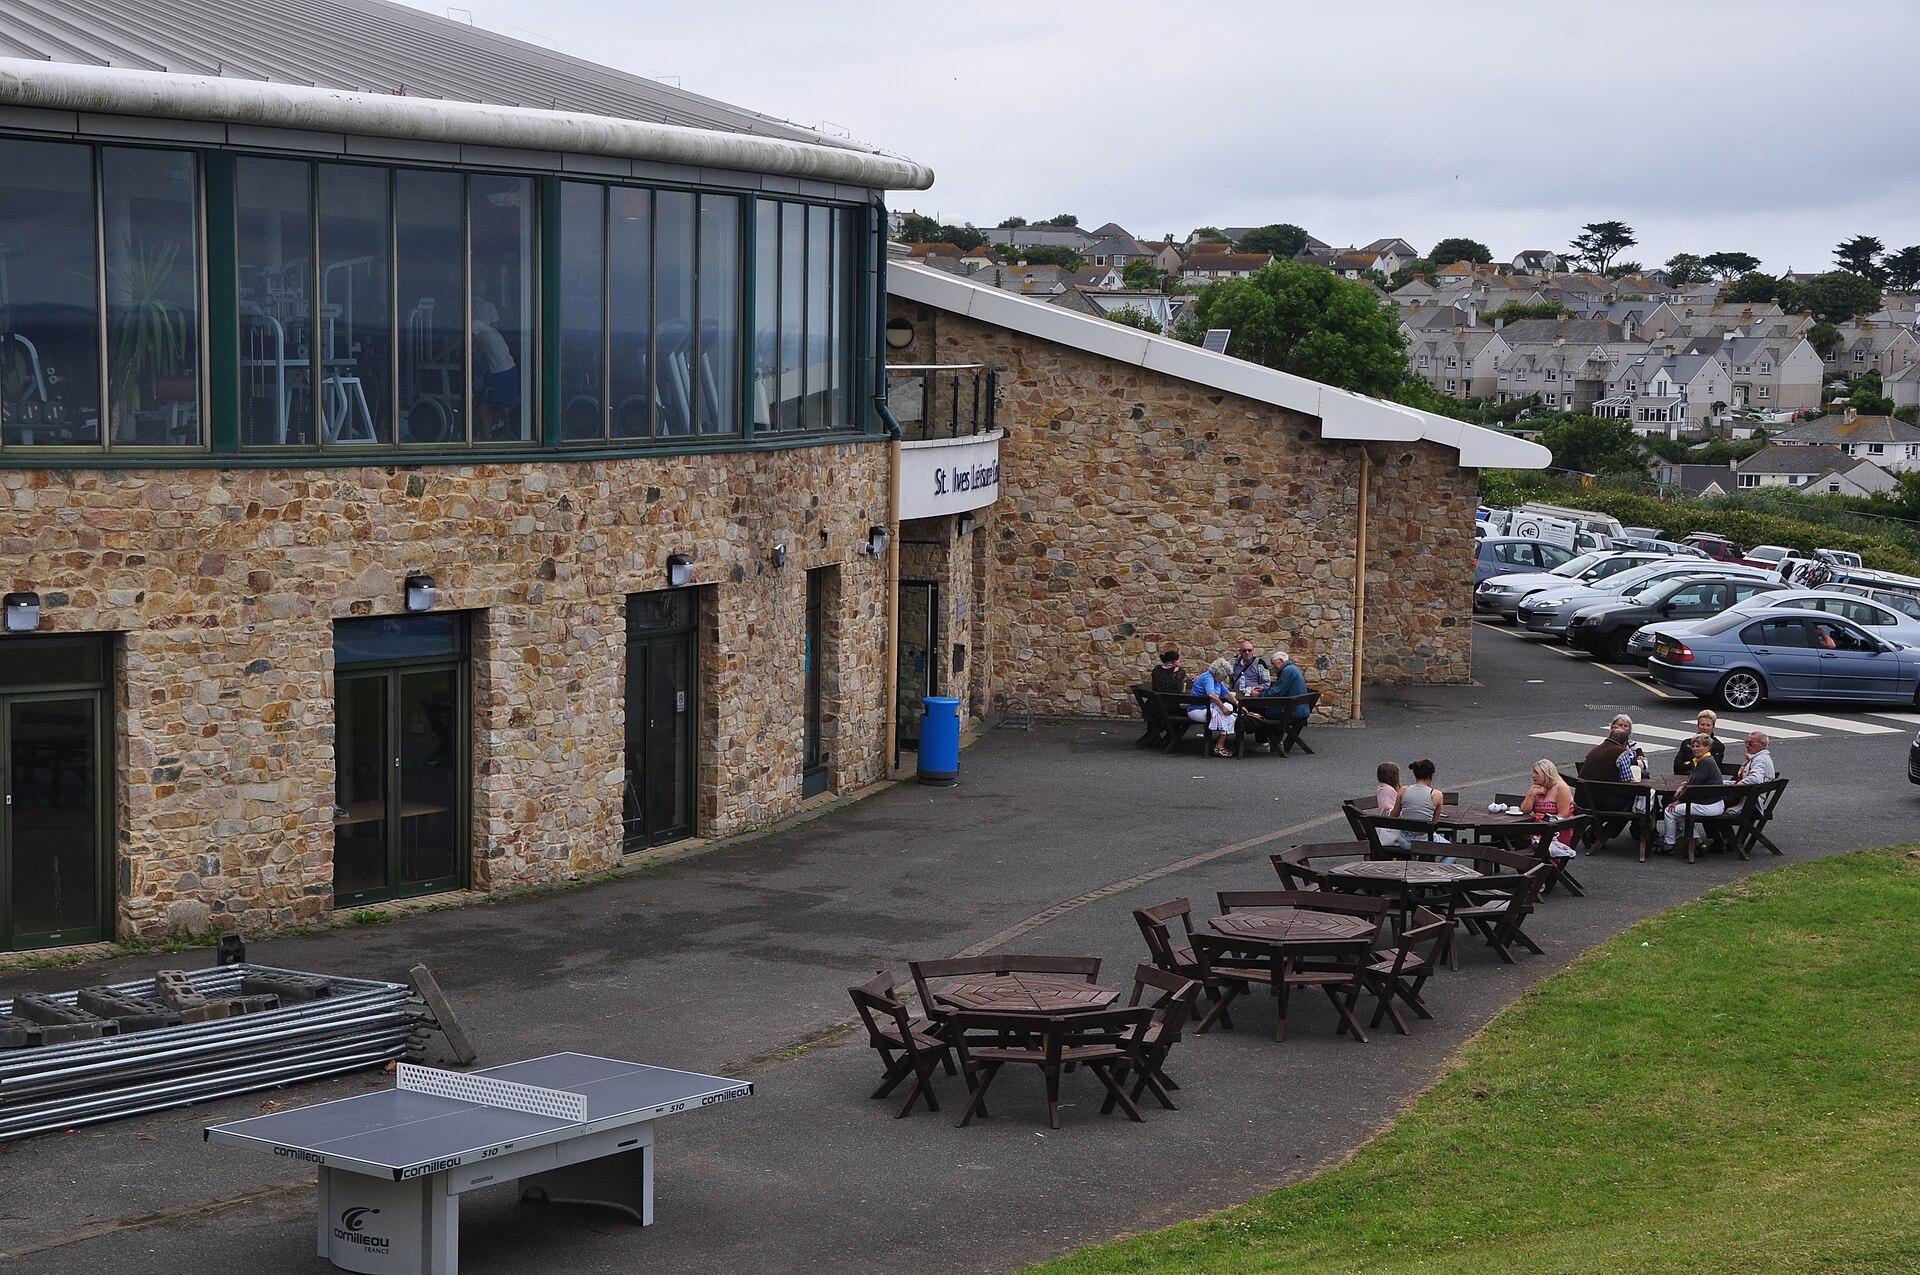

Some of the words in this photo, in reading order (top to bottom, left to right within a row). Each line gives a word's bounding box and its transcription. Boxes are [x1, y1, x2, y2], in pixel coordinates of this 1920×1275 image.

[934, 468, 949, 495] St.
[952, 467, 970, 492] Ives
[971, 463, 992, 490] Leisure
[669, 1103, 685, 1113] 510
[701, 1087, 749, 1105] cornilleau
[273, 1146, 325, 1164] cornilleau
[403, 1157, 462, 1178] cornilleau
[481, 1148, 499, 1158] 510
[333, 1228, 389, 1248] cornilleau
[364, 1247, 390, 1255] FRANCE
